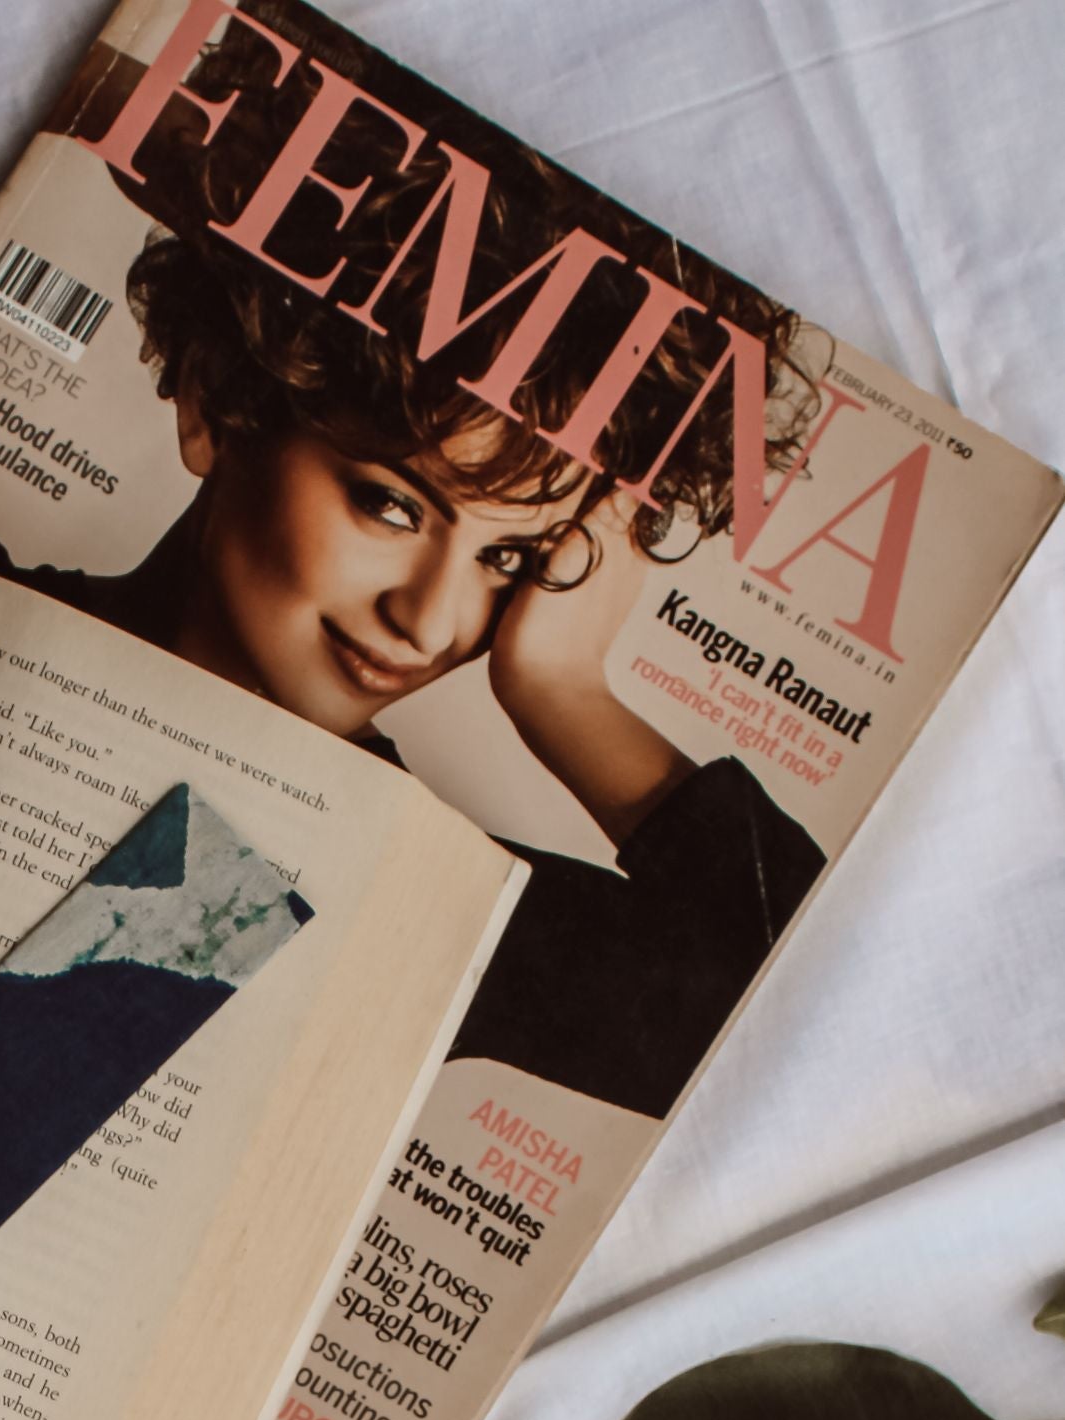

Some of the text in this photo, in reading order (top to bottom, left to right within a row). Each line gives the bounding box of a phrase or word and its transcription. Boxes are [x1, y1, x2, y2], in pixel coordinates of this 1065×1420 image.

[42, 358, 87, 399] THE
[77, 0, 904, 664] FEMINA
[827, 363, 896, 411] FEBRUARY
[914, 418, 945, 444] 2011
[49, 439, 119, 495] drives
[656, 588, 872, 744] Kangna Ranaut
[740, 580, 895, 684] www.femina.in
[9, 655, 36, 673] out
[38, 661, 90, 696] longer
[92, 688, 127, 715] than
[131, 706, 157, 729] the
[160, 724, 210, 755] sunset
[215, 749, 236, 767] we
[240, 761, 277, 786] were
[281, 781, 329, 811] watch-
[630, 656, 725, 725] romance
[724, 716, 781, 759] right
[719, 681, 777, 727] can’t
[775, 713, 803, 742] fit
[803, 731, 826, 757] in
[826, 751, 844, 773] a
[163, 1072, 202, 1095] your
[469, 1098, 582, 1184] AMISHA
[478, 1146, 559, 1216] PATEL
[387, 1167, 530, 1267] at won’t quit
[404, 1138, 545, 1240] the troubles
[362, 1215, 493, 1314] lins, roses
[362, 1254, 409, 1307] big
[406, 1281, 480, 1343] bowl
[335, 1275, 462, 1372] spaghetti
[309, 1332, 432, 1419] osuctions
